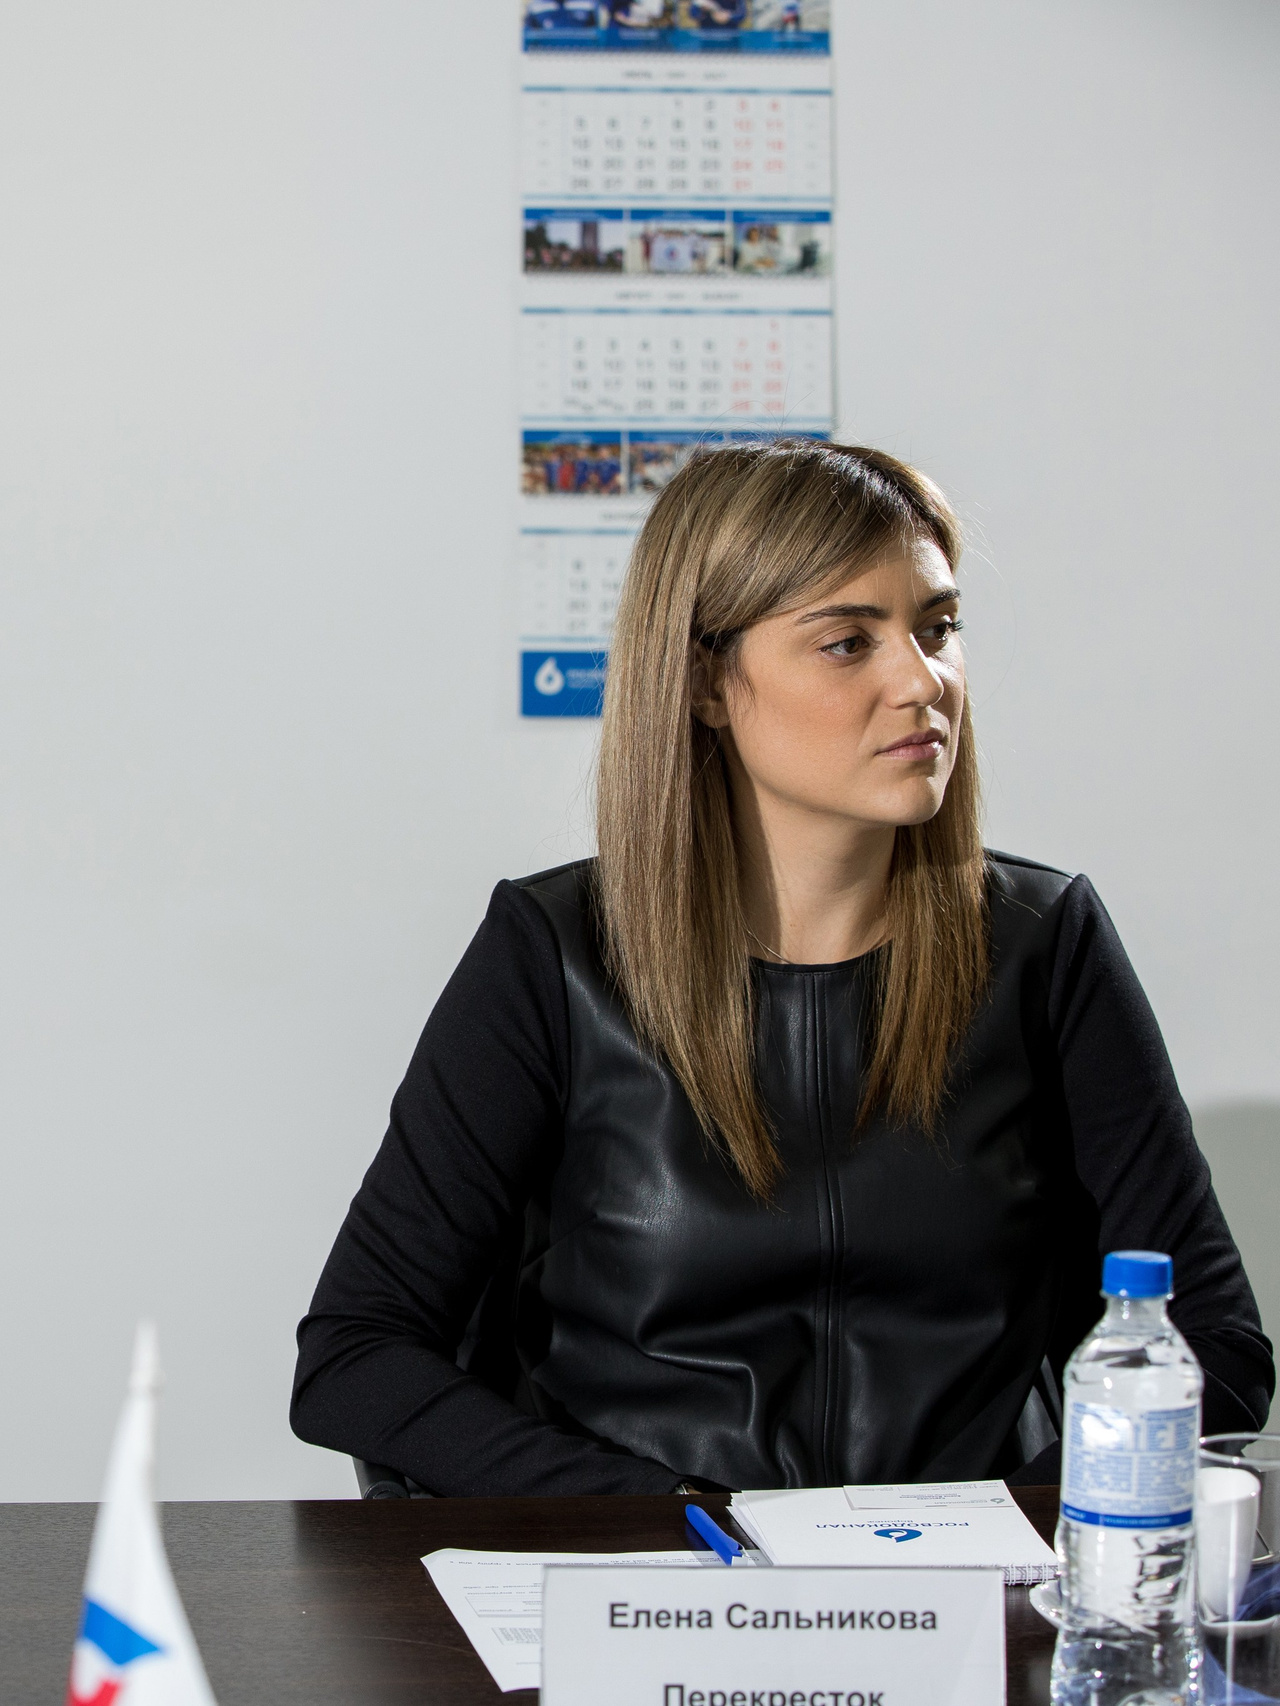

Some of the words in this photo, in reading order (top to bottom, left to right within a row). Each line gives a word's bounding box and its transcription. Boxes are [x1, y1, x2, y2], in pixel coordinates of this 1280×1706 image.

[609, 1602, 713, 1629] Елена
[725, 1602, 937, 1631] Сальникова
[663, 1683, 884, 1706] Перекресток
